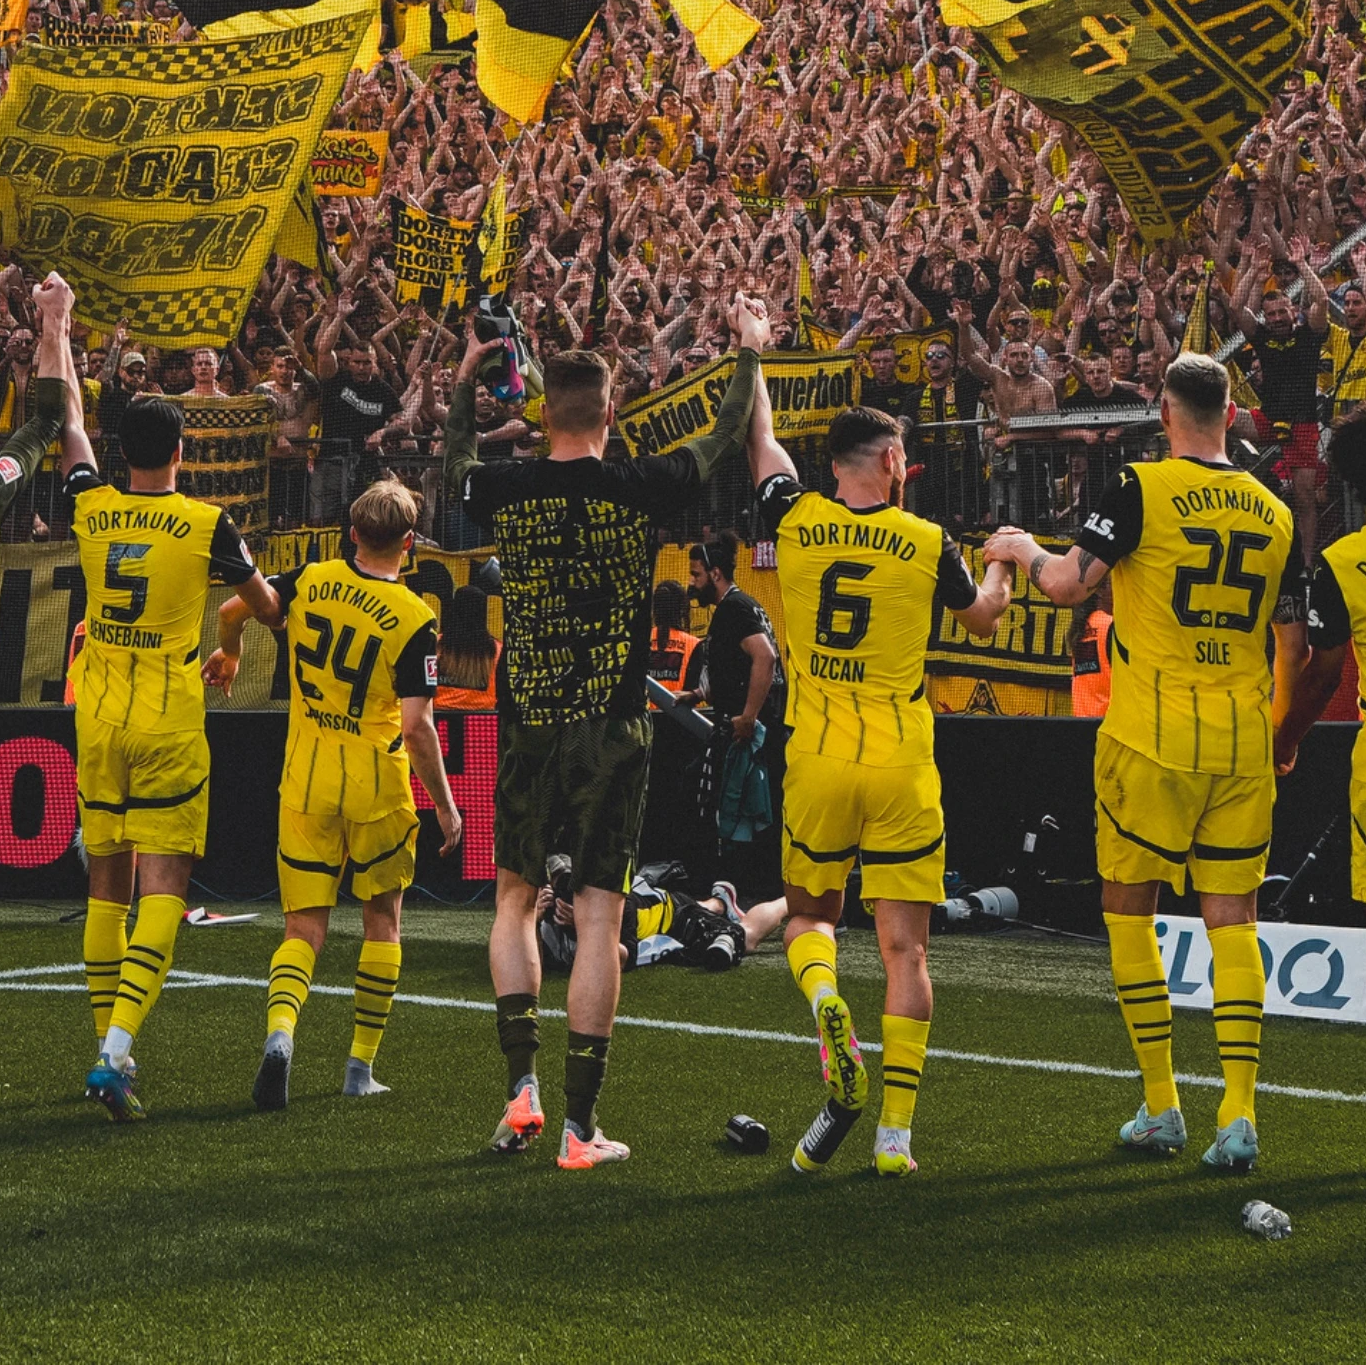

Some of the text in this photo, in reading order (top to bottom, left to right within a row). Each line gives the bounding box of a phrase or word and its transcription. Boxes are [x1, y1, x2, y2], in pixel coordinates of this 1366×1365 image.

[625, 367, 856, 457] Sektion Stnverbot
[87, 510, 192, 539] DORTMUND
[1172, 487, 1276, 527] DORTMUND
[798, 523, 917, 562] DORTMUND
[102, 542, 153, 624] 5
[308, 581, 400, 632] DORTMUND
[816, 561, 876, 650] 6
[1171, 527, 1273, 633] 25
[294, 612, 383, 718] 24
[1195, 637, 1231, 666] SÜLE
